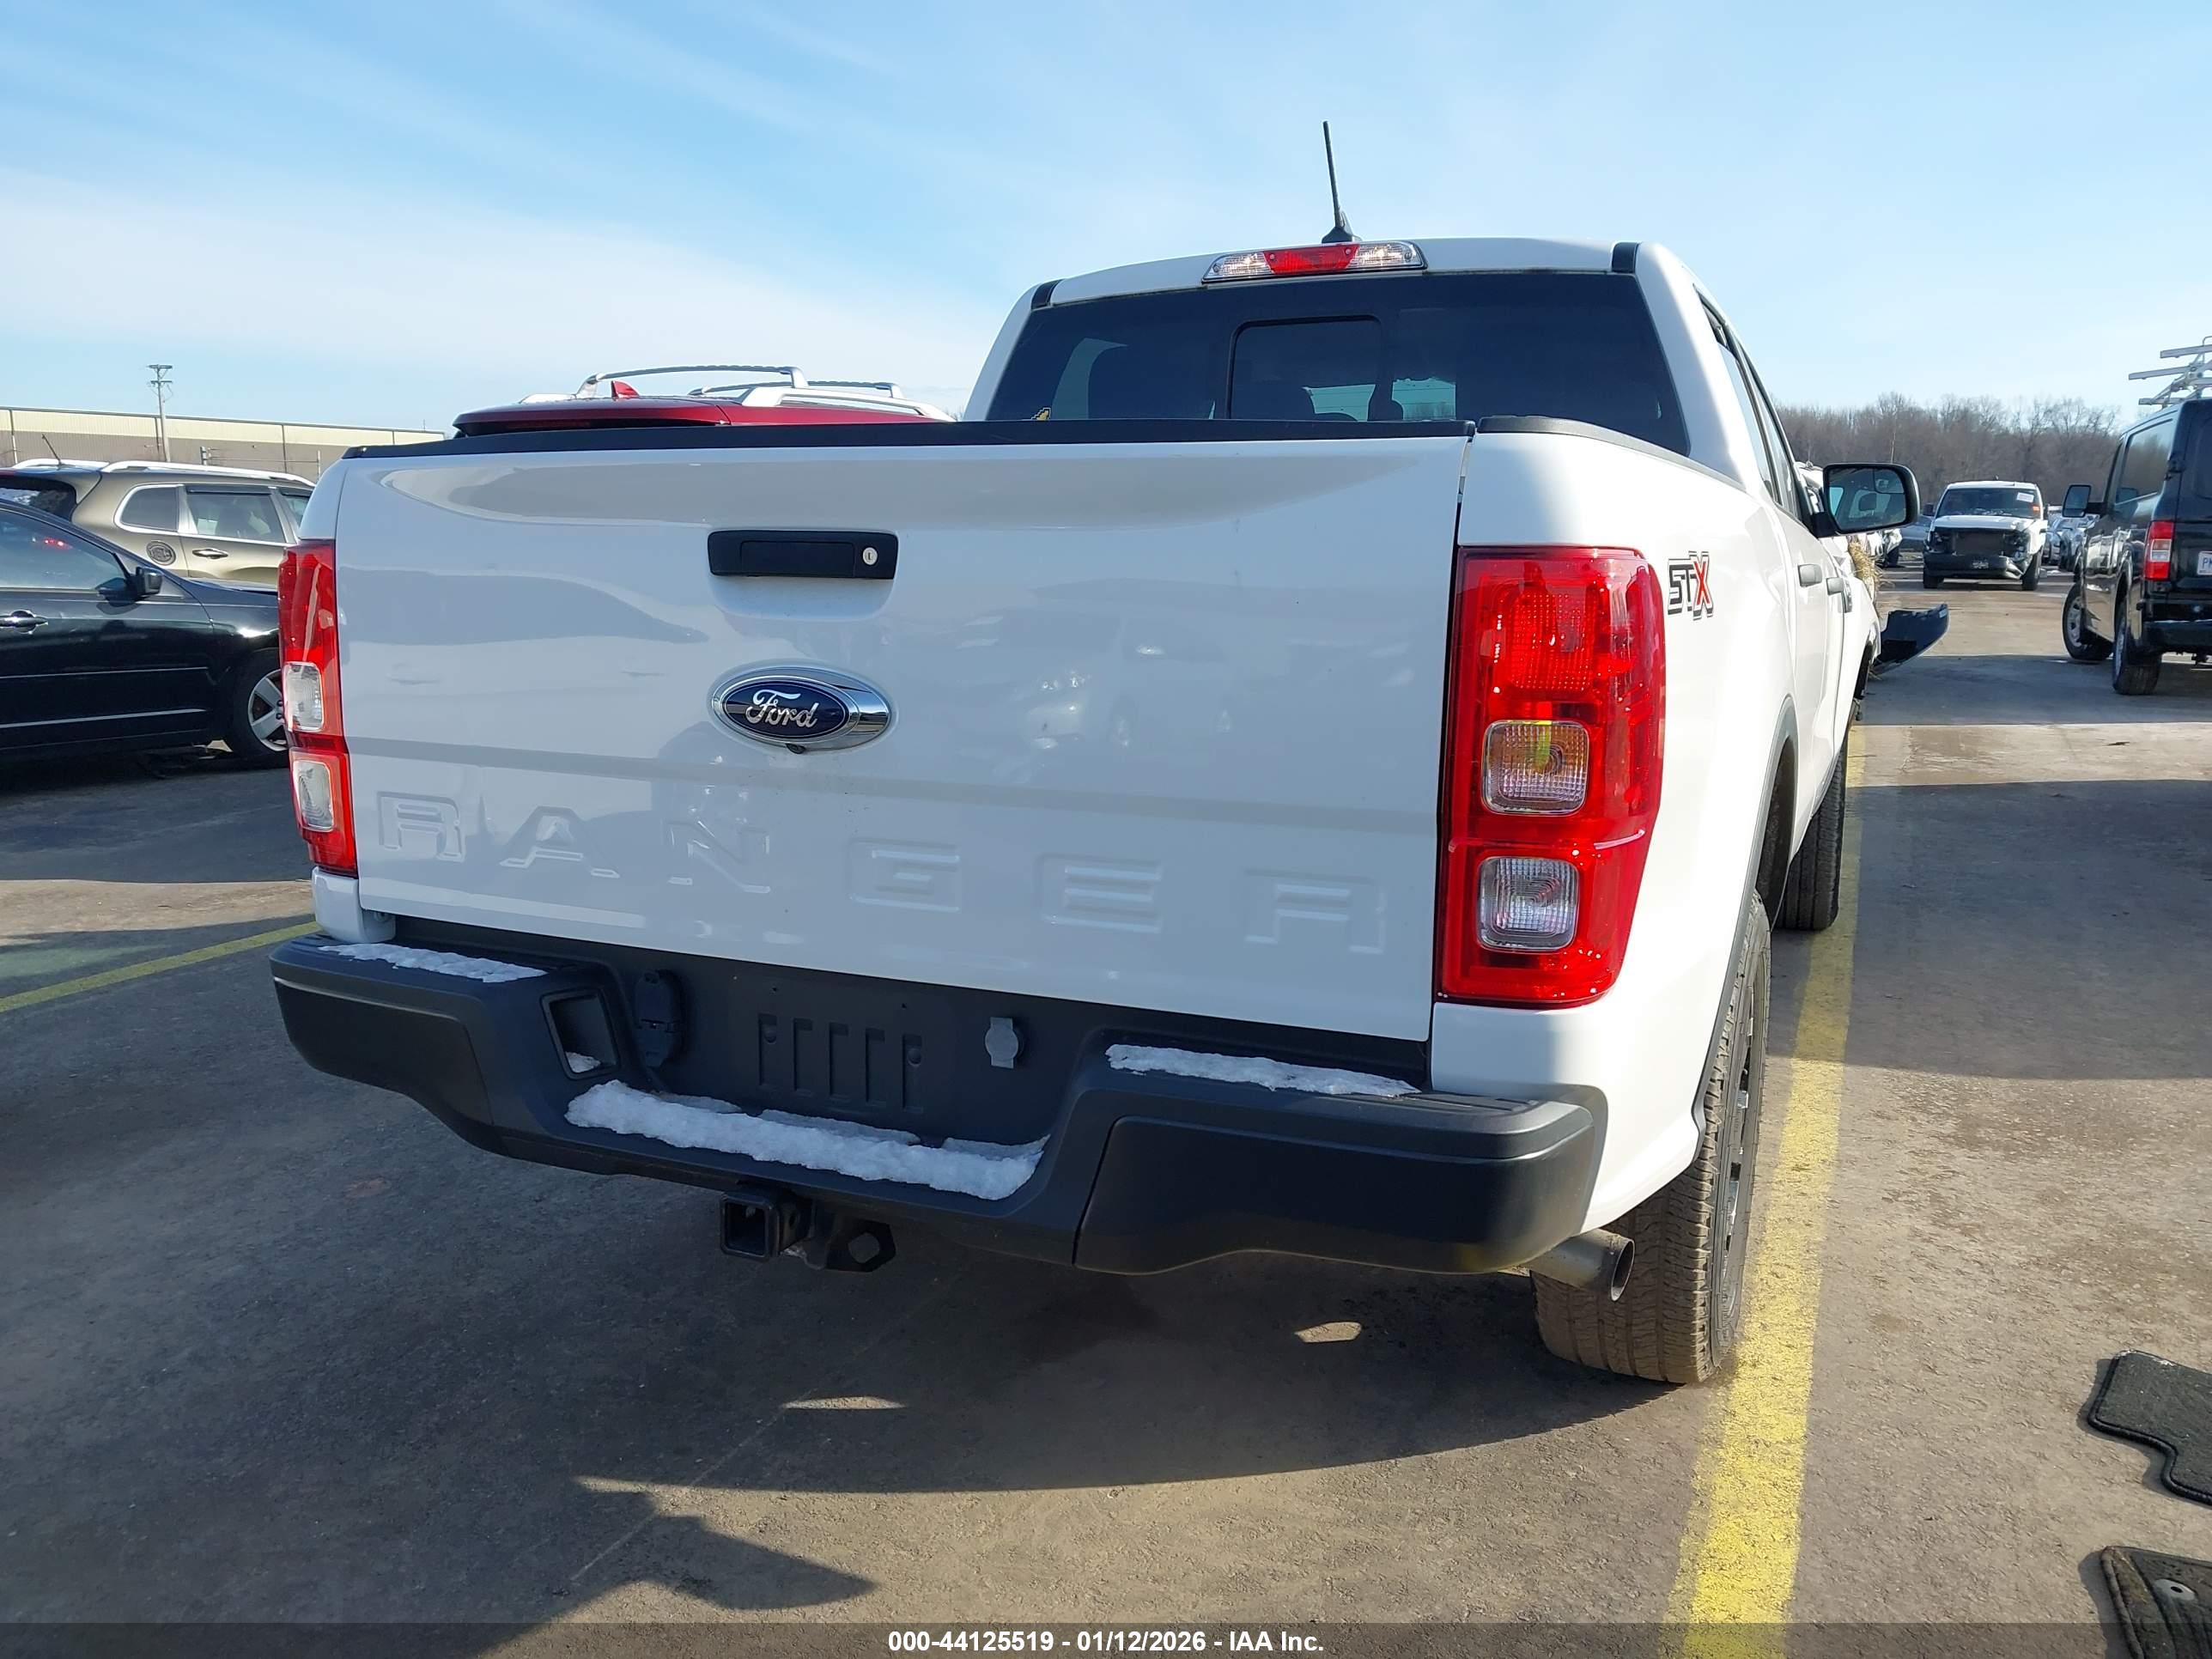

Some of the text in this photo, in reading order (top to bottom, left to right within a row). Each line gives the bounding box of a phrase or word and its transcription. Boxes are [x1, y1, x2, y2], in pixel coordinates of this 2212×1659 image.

[1668, 550, 1713, 621] STX
[745, 689, 819, 728] Ford
[376, 790, 1385, 954] RANGER
